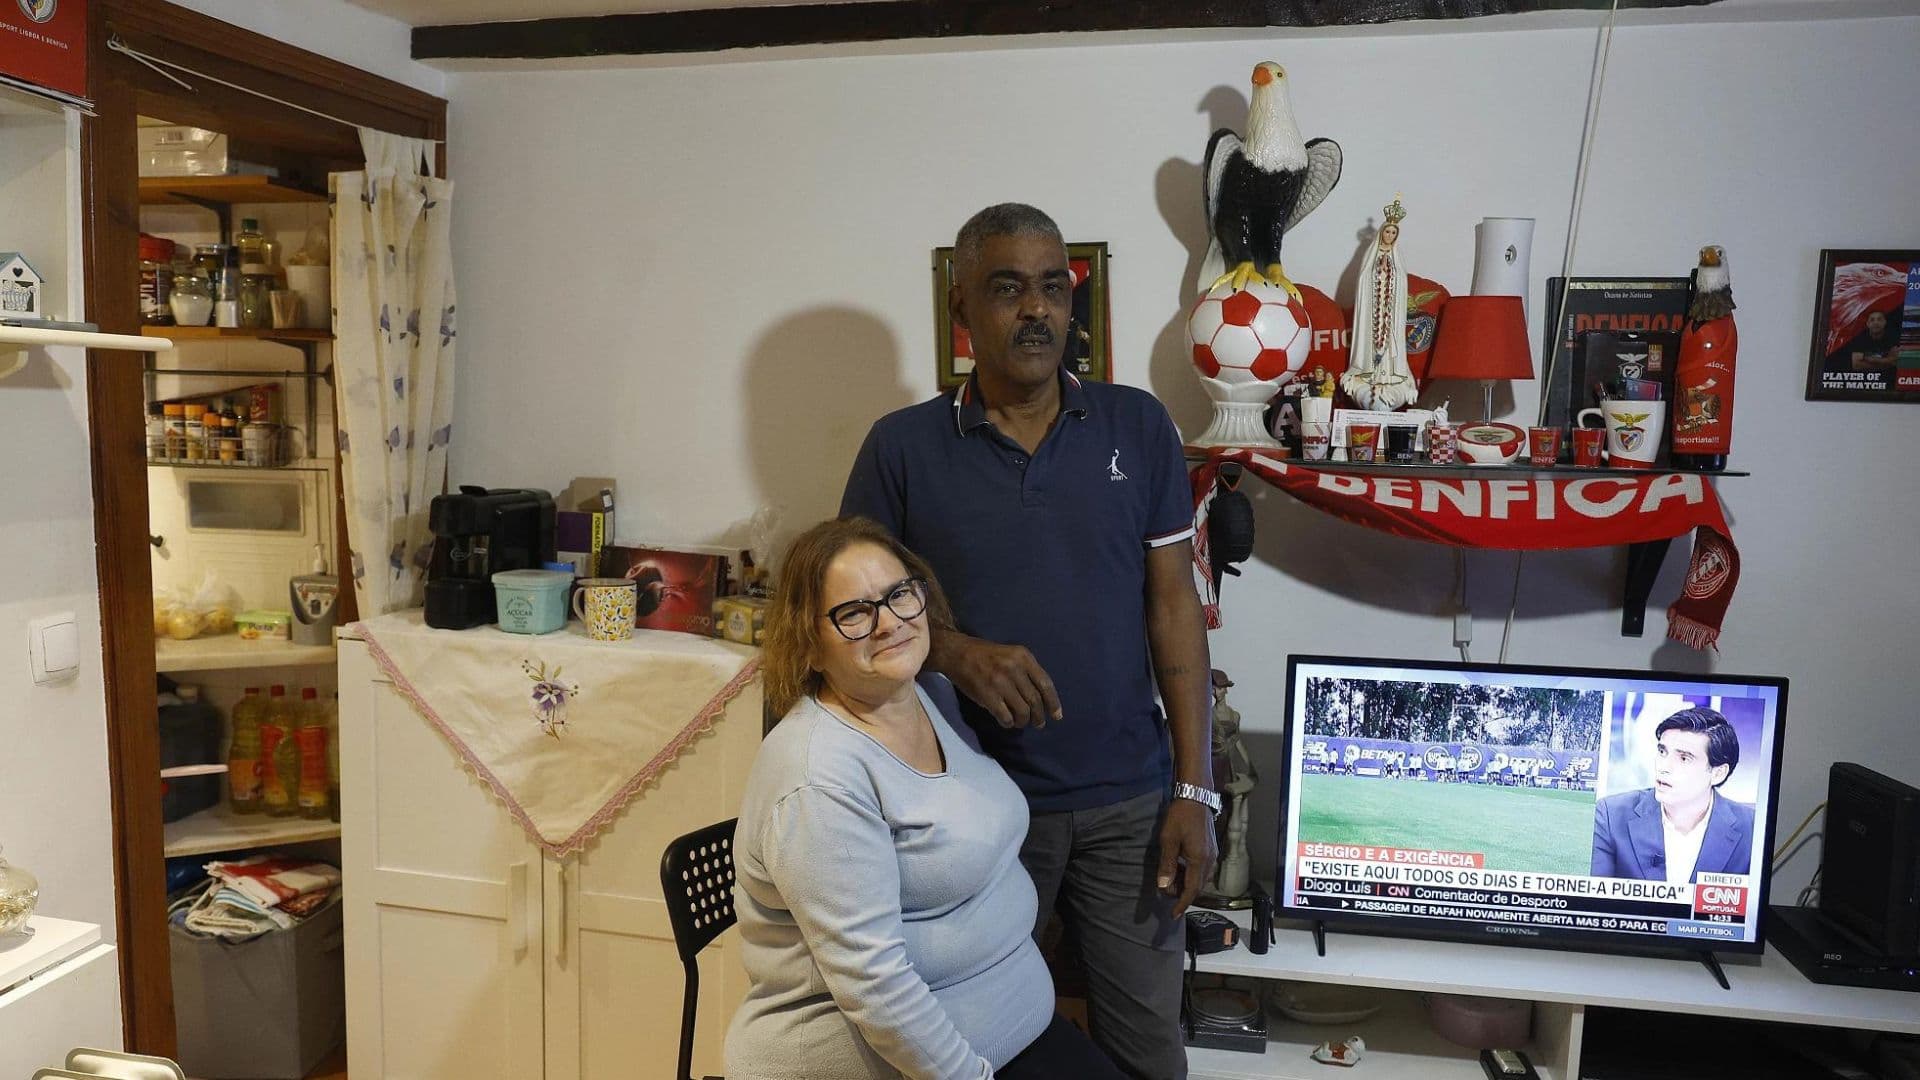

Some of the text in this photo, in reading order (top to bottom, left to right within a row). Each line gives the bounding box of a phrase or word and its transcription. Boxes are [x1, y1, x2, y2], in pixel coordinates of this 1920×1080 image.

[19, 28, 40, 40] LISBOA
[1822, 372, 1882, 382] PLAYER OF
[1822, 381, 1887, 390] THE MATCH
[1317, 473, 1704, 520] BENFICA
[1305, 843, 1476, 867] SÉRGIO E A EXIGÊNCIA
[1305, 861, 1685, 900] "EXISTE AQUI TODOS OS DIAS E TORNEI-A PÚBLICA"
[1704, 874, 1742, 885] DIRETO
[1303, 878, 1568, 909] Diogo Luís CNN Comentador de Desporto
[1702, 886, 1741, 906] CNN
[1354, 900, 1411, 913] PASSAGEM
[1412, 905, 1427, 914] DE
[1428, 905, 1464, 917] RAFAH
[1465, 908, 1531, 922] NOVAMENTE
[1531, 913, 1574, 925] ABERTA
[1575, 916, 1600, 927] MAS
[1601, 917, 1618, 929] SÓ
[1619, 920, 1650, 931] PARA
[1702, 904, 1739, 913] PORTUGAL
[1678, 925, 1735, 936] MAIS FUTEBOL
